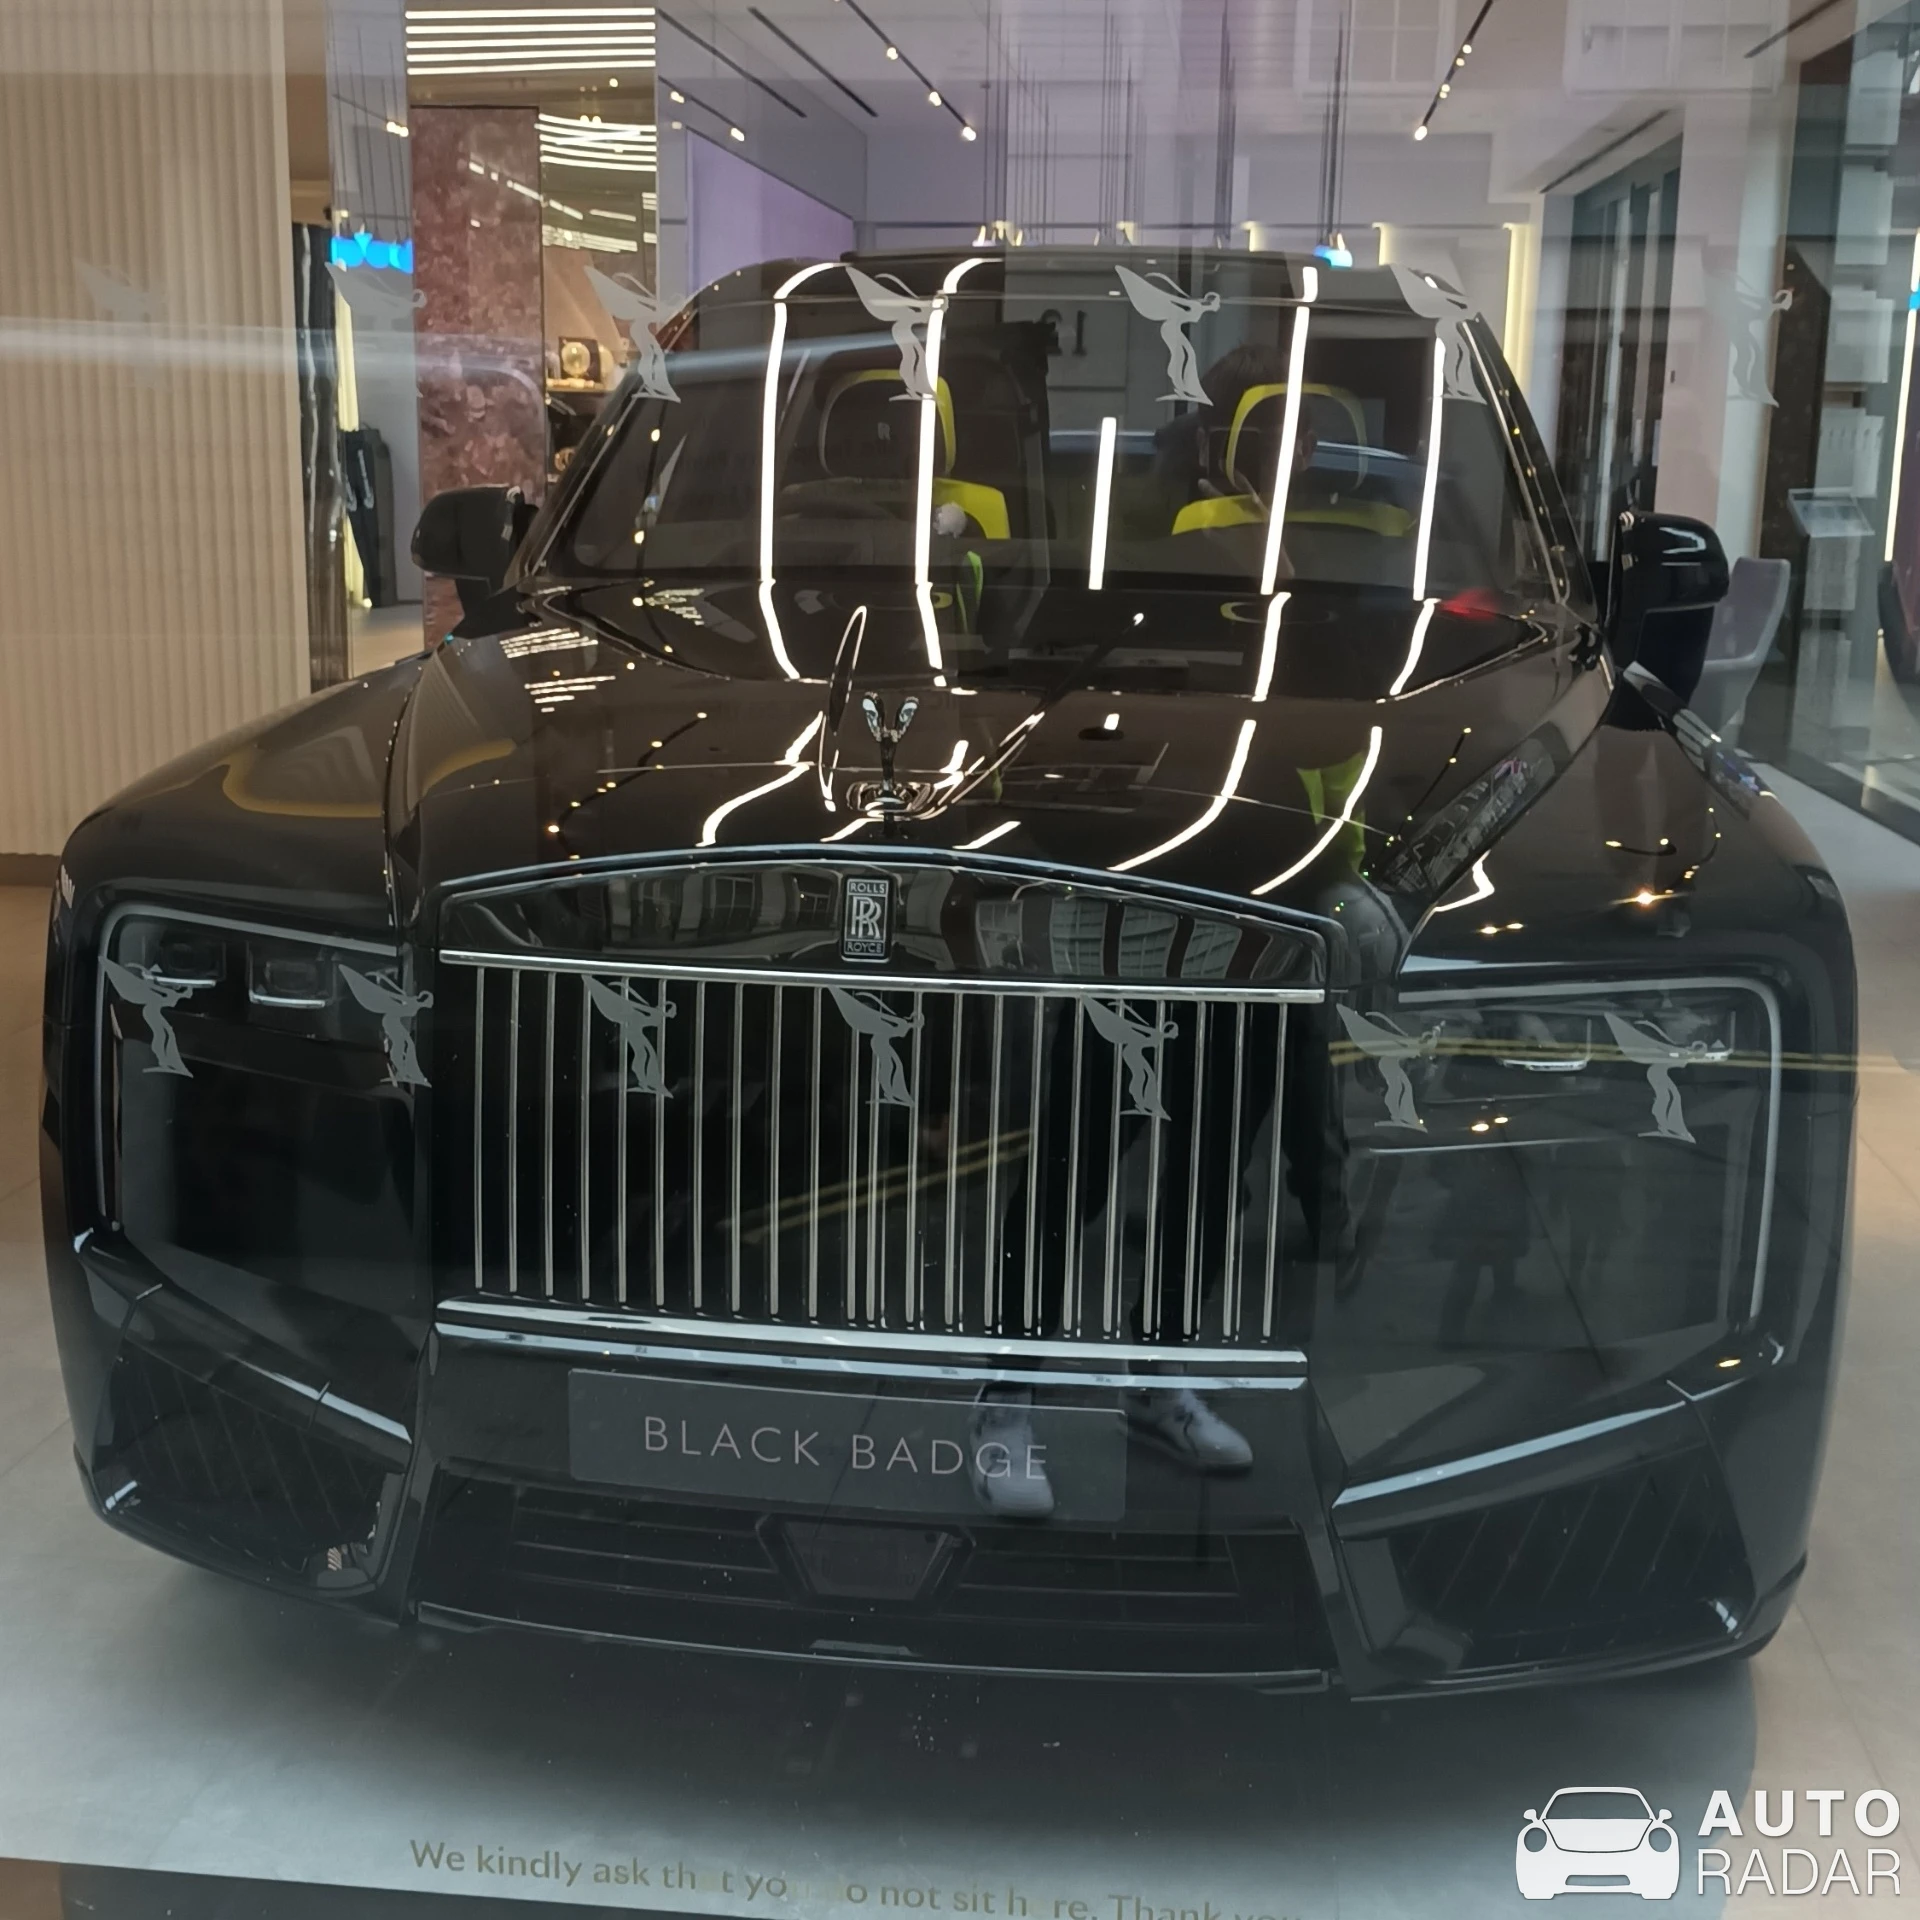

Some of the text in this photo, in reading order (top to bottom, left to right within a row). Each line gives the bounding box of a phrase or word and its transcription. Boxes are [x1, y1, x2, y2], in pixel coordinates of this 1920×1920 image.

[850, 882, 885, 894] ROLLS
[847, 941, 882, 953] ROYCE
[644, 1416, 1049, 1480] BLACK BADGE
[410, 1839, 465, 1872] We
[477, 1844, 583, 1887] kindly
[593, 1857, 651, 1887] ask
[662, 1861, 735, 1894] tht
[744, 1872, 811, 1902] yo
[881, 1884, 941, 1911] not
[952, 1882, 996, 1914] sit
[1007, 1886, 1098, 1920] hre.
